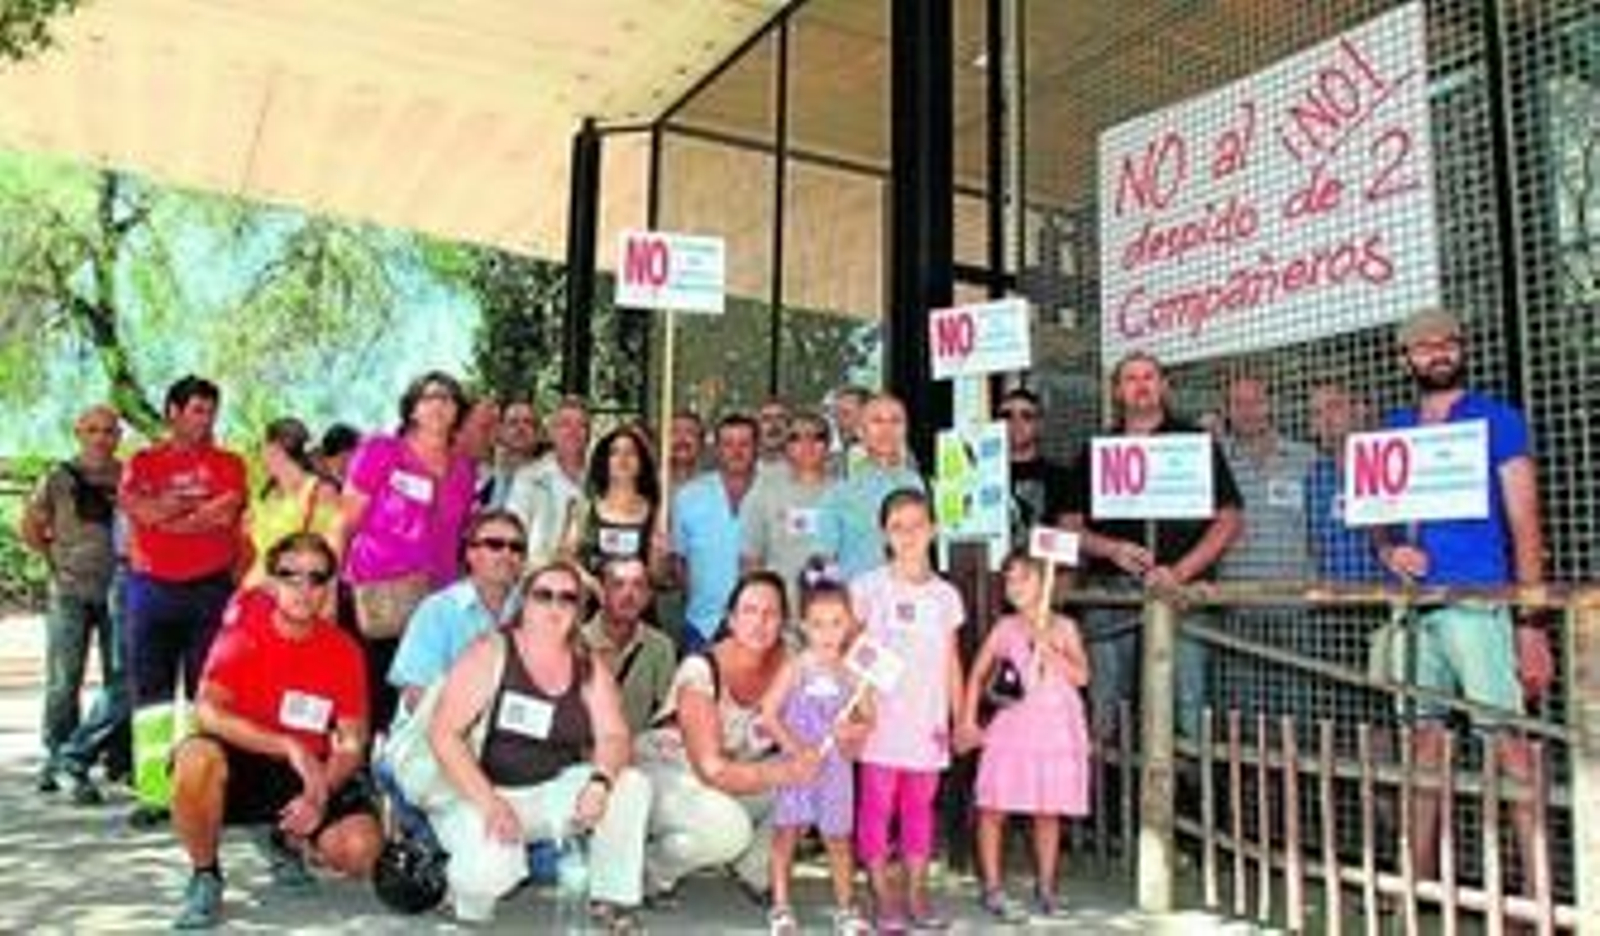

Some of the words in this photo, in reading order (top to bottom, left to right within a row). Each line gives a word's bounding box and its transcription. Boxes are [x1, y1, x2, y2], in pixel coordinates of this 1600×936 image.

[1115, 132, 1187, 216] NO
[1211, 102, 1255, 180] al
[1122, 195, 1259, 270] despido
[1284, 161, 1344, 219] de
[1367, 128, 1421, 201] 2
[624, 237, 669, 286] NO
[937, 312, 974, 358] NO
[1099, 444, 1146, 496] NO
[1354, 437, 1410, 498] NO
